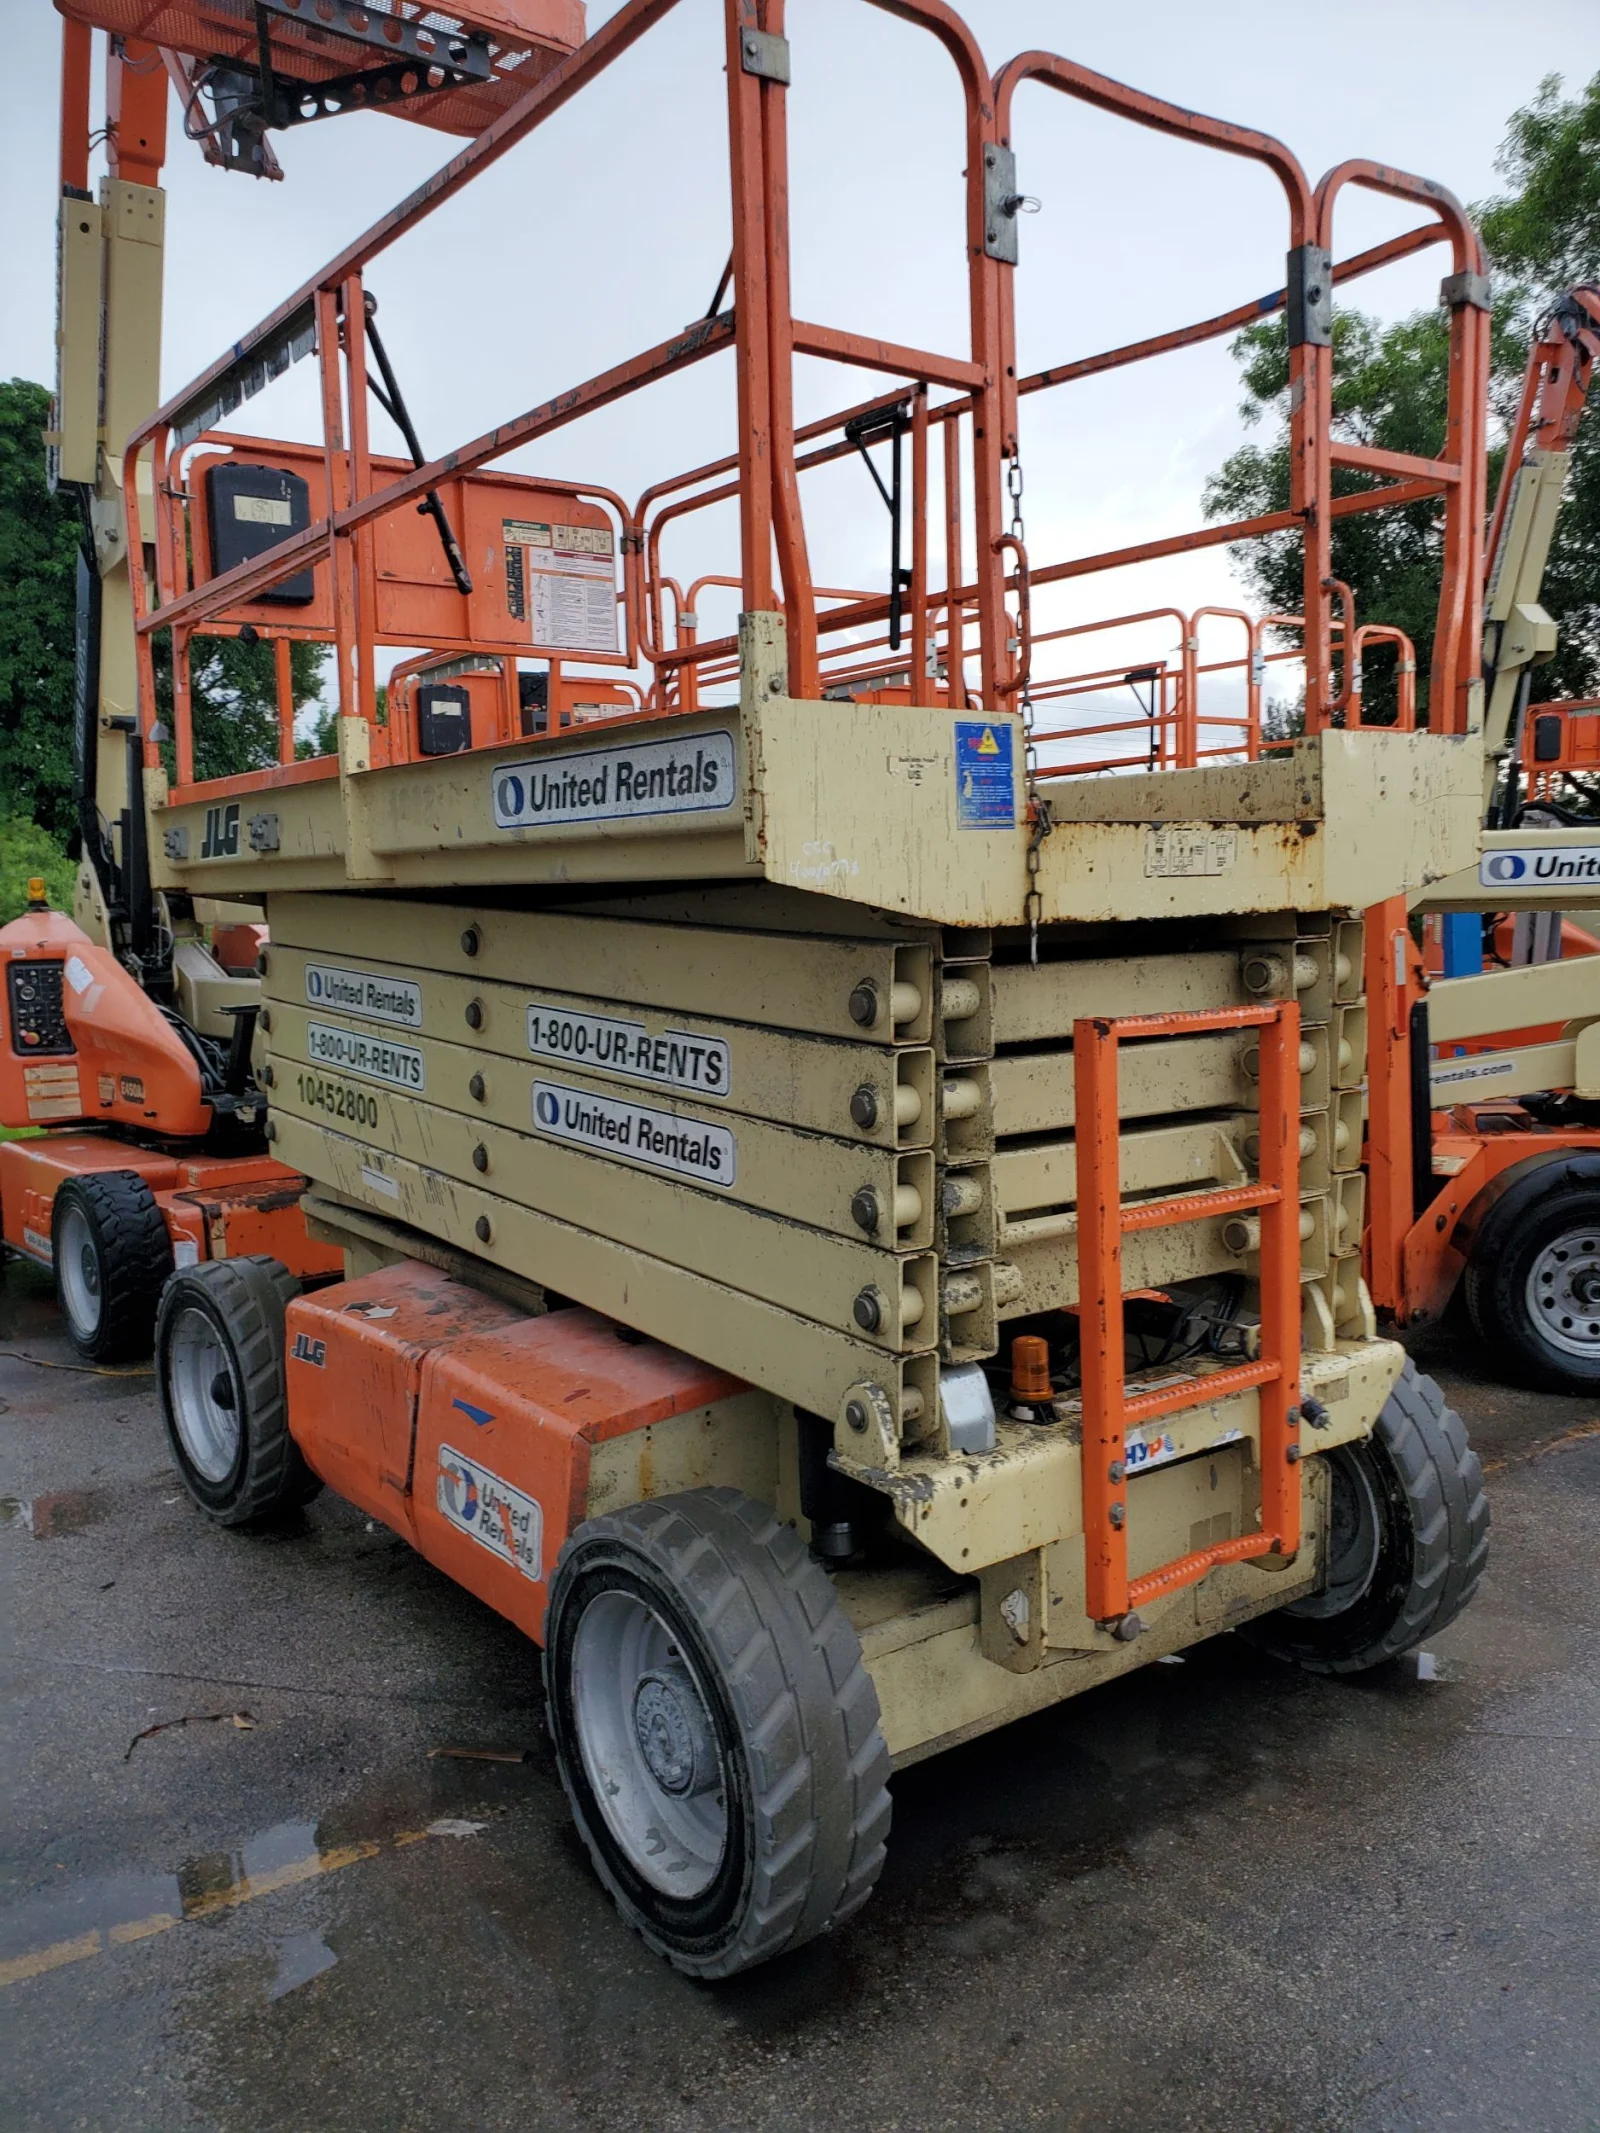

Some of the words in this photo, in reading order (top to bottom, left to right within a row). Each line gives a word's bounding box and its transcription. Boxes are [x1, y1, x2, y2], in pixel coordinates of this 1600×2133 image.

[530, 765, 608, 812] United
[616, 750, 719, 802] Rentals
[201, 803, 240, 859] JLG
[1534, 854, 1600, 878] Unit
[324, 975, 364, 1006] United
[366, 983, 415, 1017] Rentals
[309, 1030, 420, 1084] 1-800-UR-RENTS
[531, 1016, 723, 1086] 1-800-UR-RENTS
[1430, 1064, 1513, 1084] rentals.com
[297, 1073, 377, 1129] 10452800
[564, 1099, 632, 1146] United
[636, 1117, 722, 1171] Rentals
[291, 1333, 326, 1367] JLG
[482, 1483, 530, 1534] Uned
[479, 1510, 533, 1565] Renals
